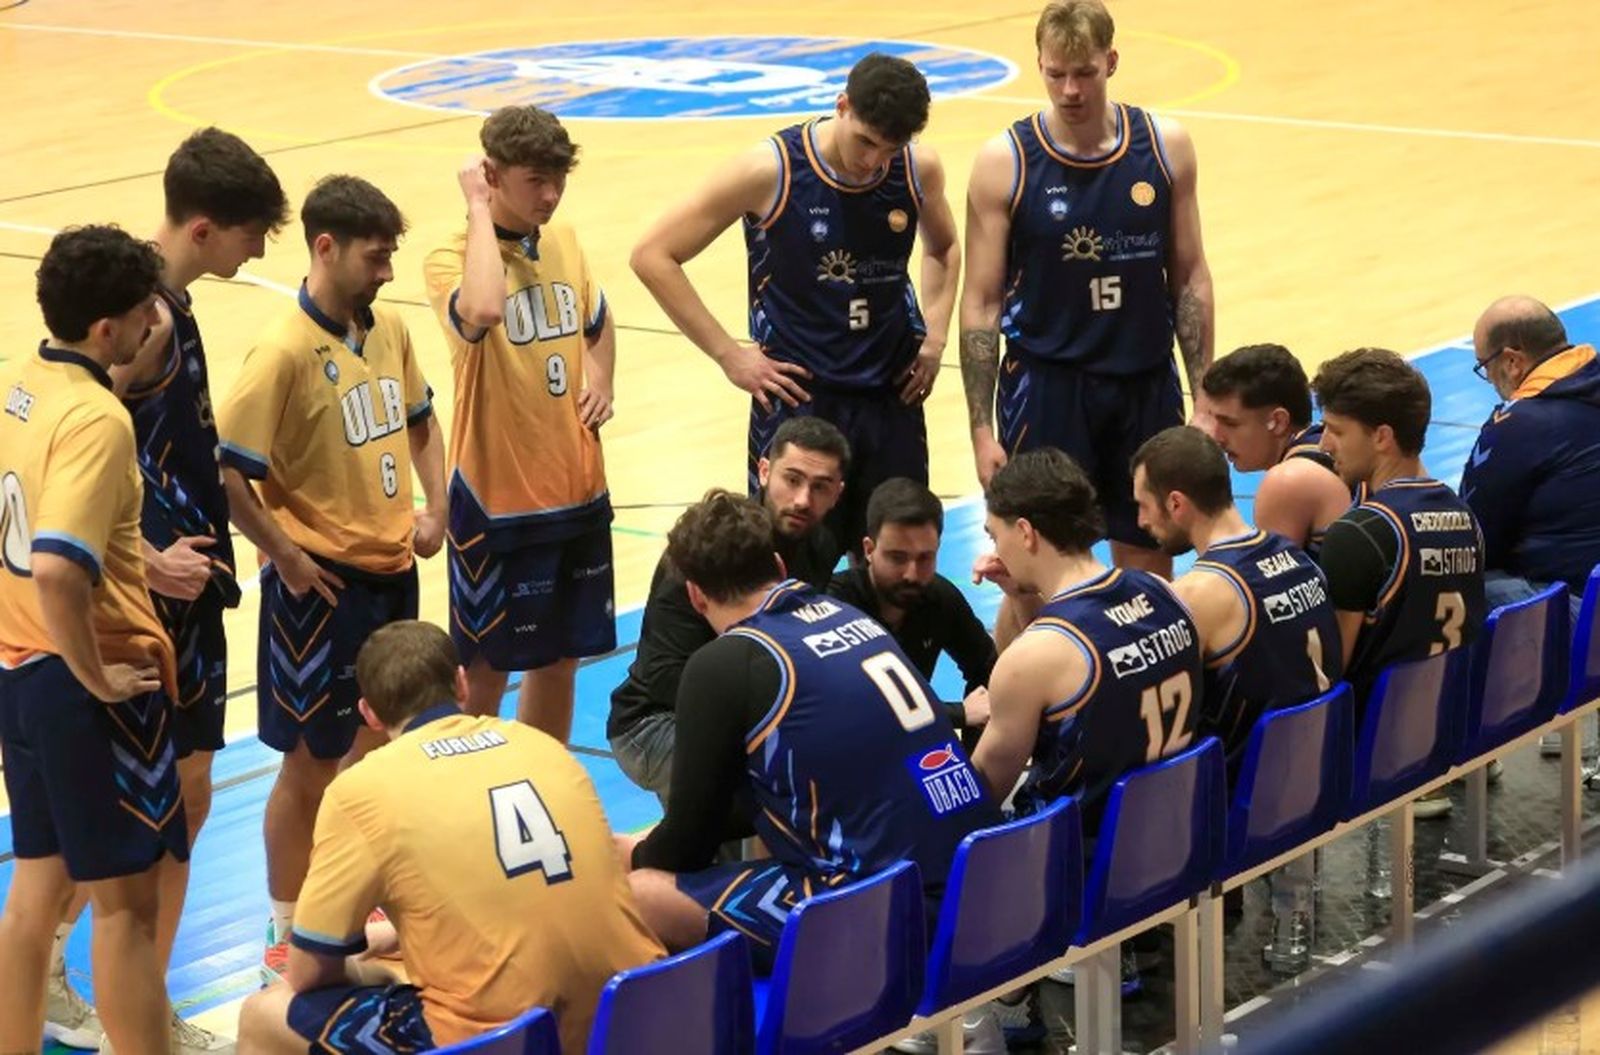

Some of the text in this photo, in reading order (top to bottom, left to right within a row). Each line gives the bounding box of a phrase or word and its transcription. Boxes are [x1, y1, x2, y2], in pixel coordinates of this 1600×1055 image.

[506, 282, 578, 345] ULB
[849, 298, 870, 330] 5
[1089, 275, 1122, 311] 15
[547, 354, 567, 396] 9
[341, 376, 404, 447] ULB
[380, 452, 398, 498] 6
[1104, 593, 1155, 628] YOME
[1428, 591, 1467, 657] 3
[1139, 619, 1192, 665] STROG
[861, 651, 935, 732] 0
[1140, 670, 1193, 763] 12
[420, 729, 508, 760] FURLAN
[924, 768, 981, 814] UBAGO
[488, 779, 574, 886] 4
